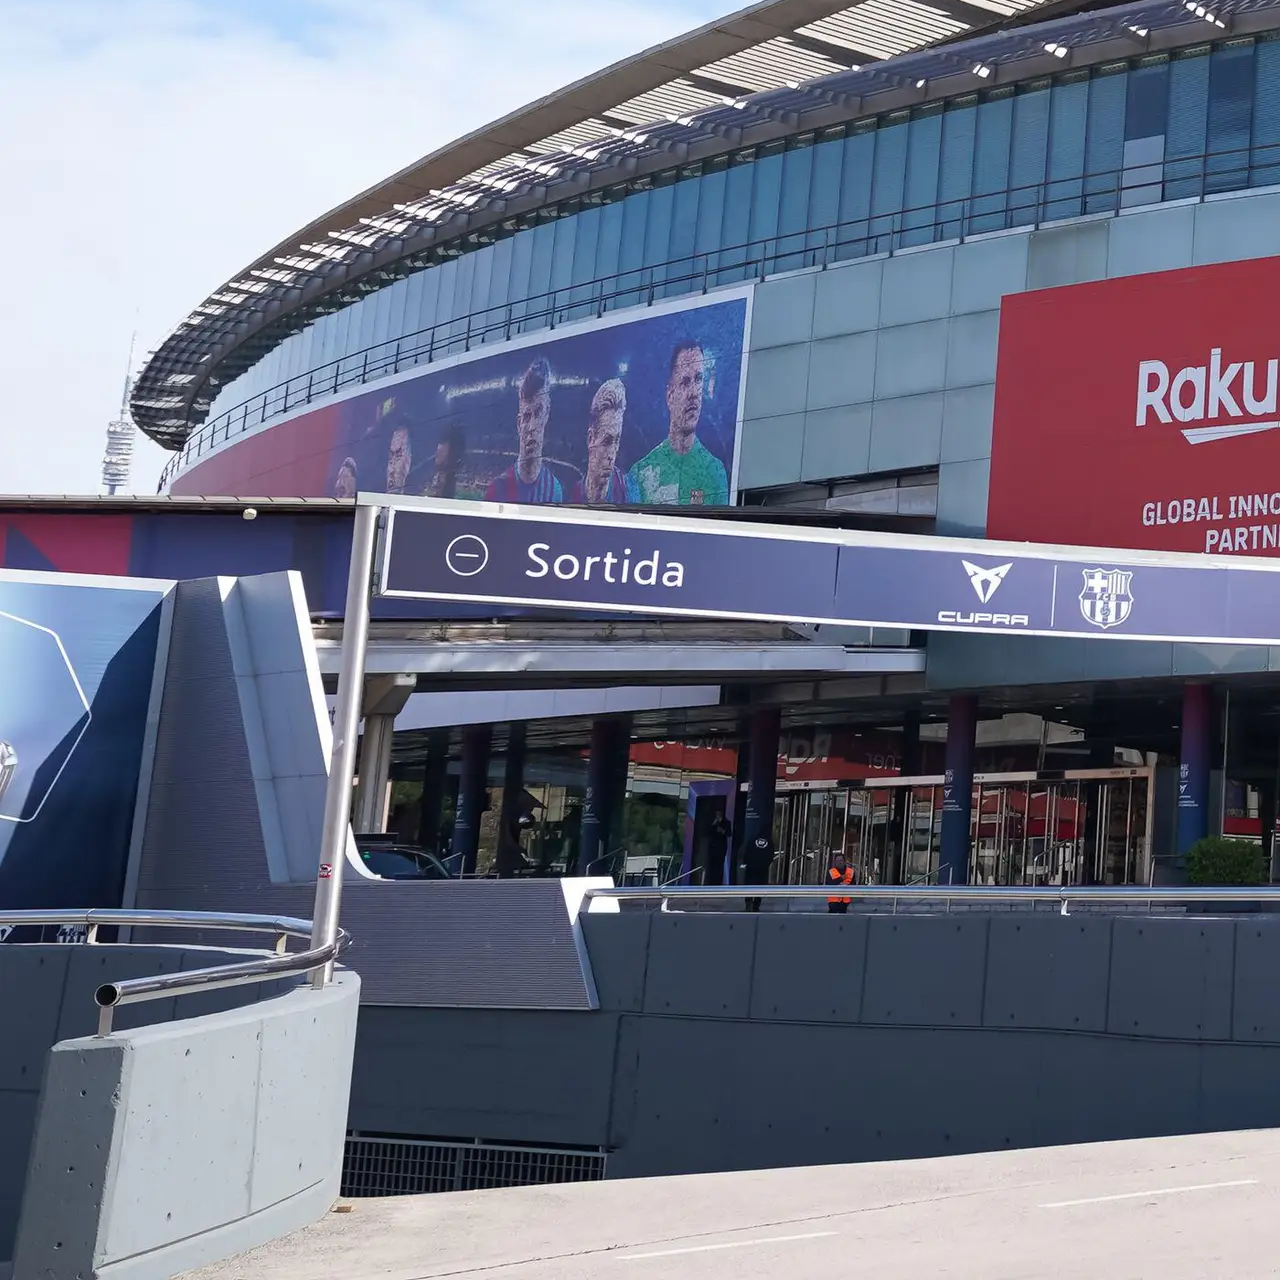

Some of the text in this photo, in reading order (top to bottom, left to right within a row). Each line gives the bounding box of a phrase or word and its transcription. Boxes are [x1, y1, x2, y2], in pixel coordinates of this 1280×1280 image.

[1142, 496, 1224, 527] GLOBAL
[525, 542, 685, 588] Sortida
[938, 611, 1029, 626] CUPRA
